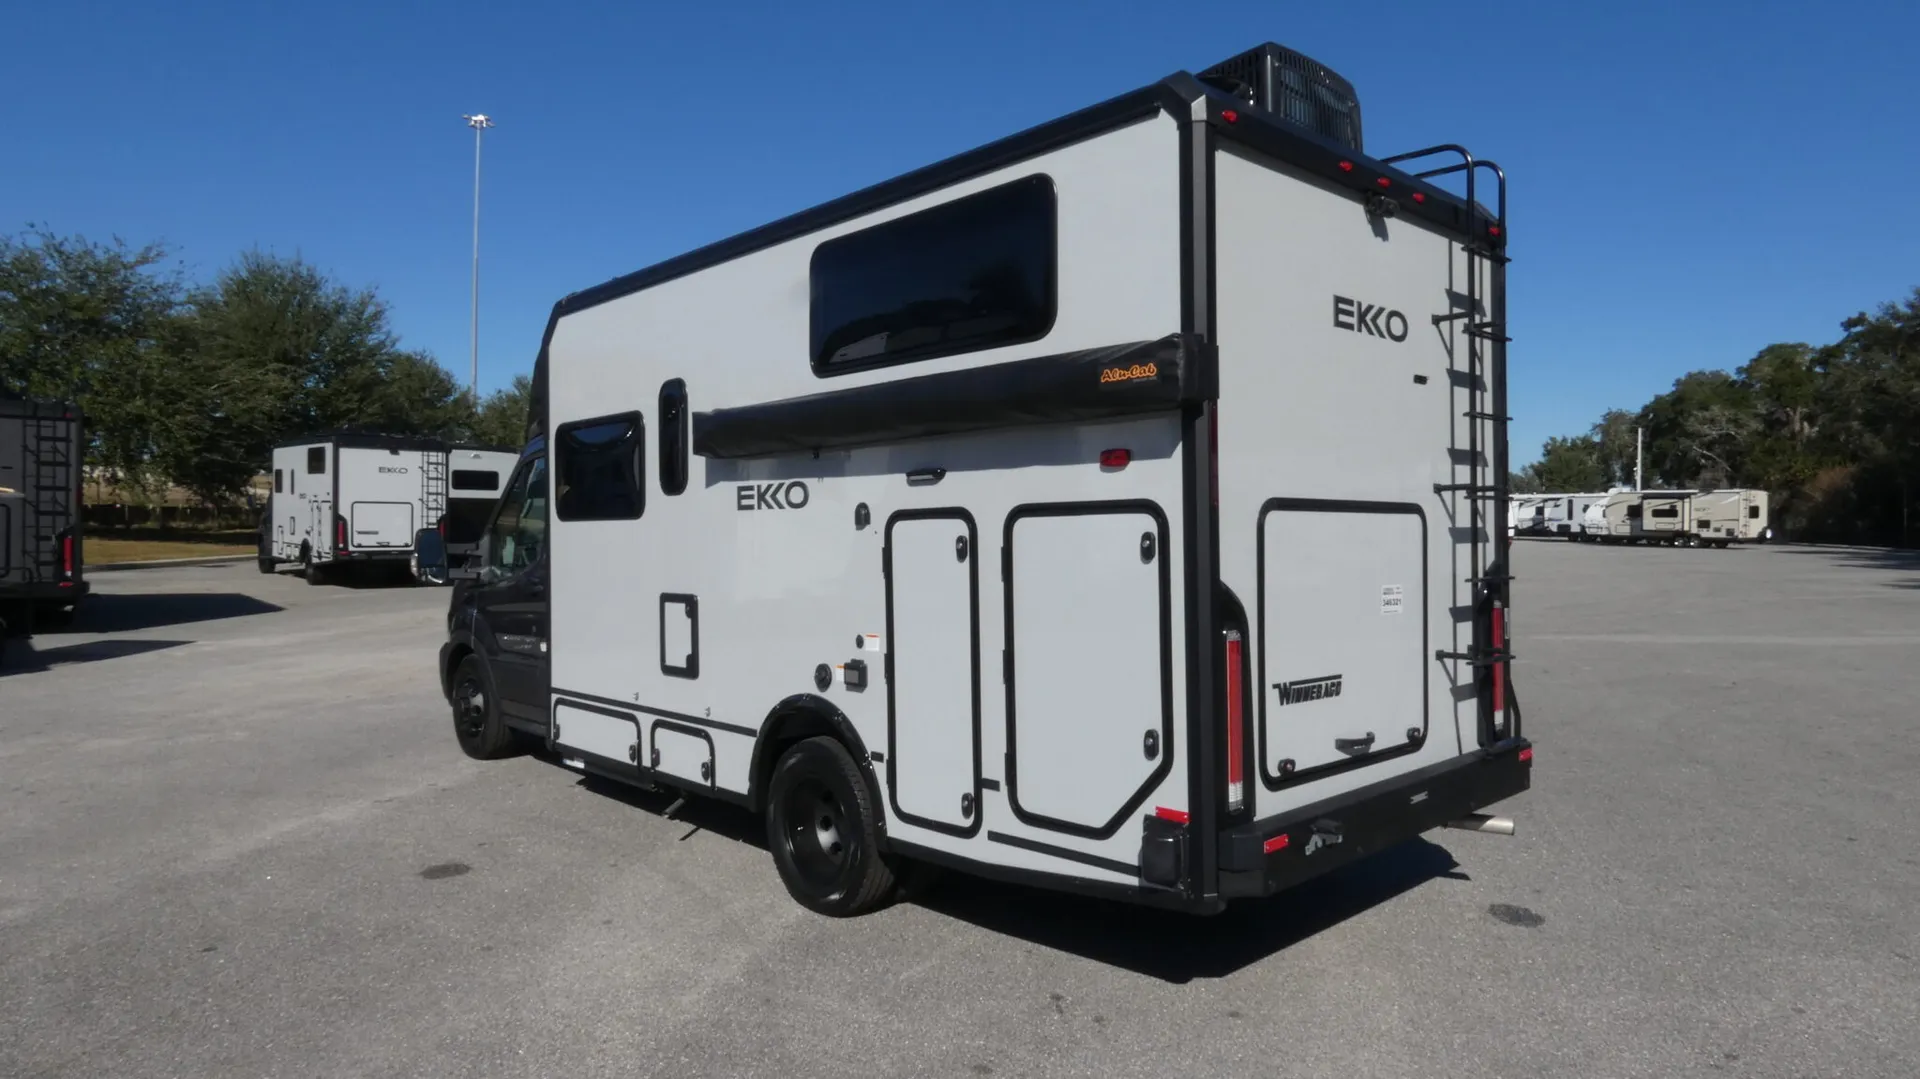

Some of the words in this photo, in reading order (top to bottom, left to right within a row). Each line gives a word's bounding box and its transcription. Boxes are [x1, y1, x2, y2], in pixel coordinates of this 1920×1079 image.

[1332, 294, 1409, 344] EKKO
[378, 466, 409, 474] EKKO
[737, 480, 810, 511] EKKO
